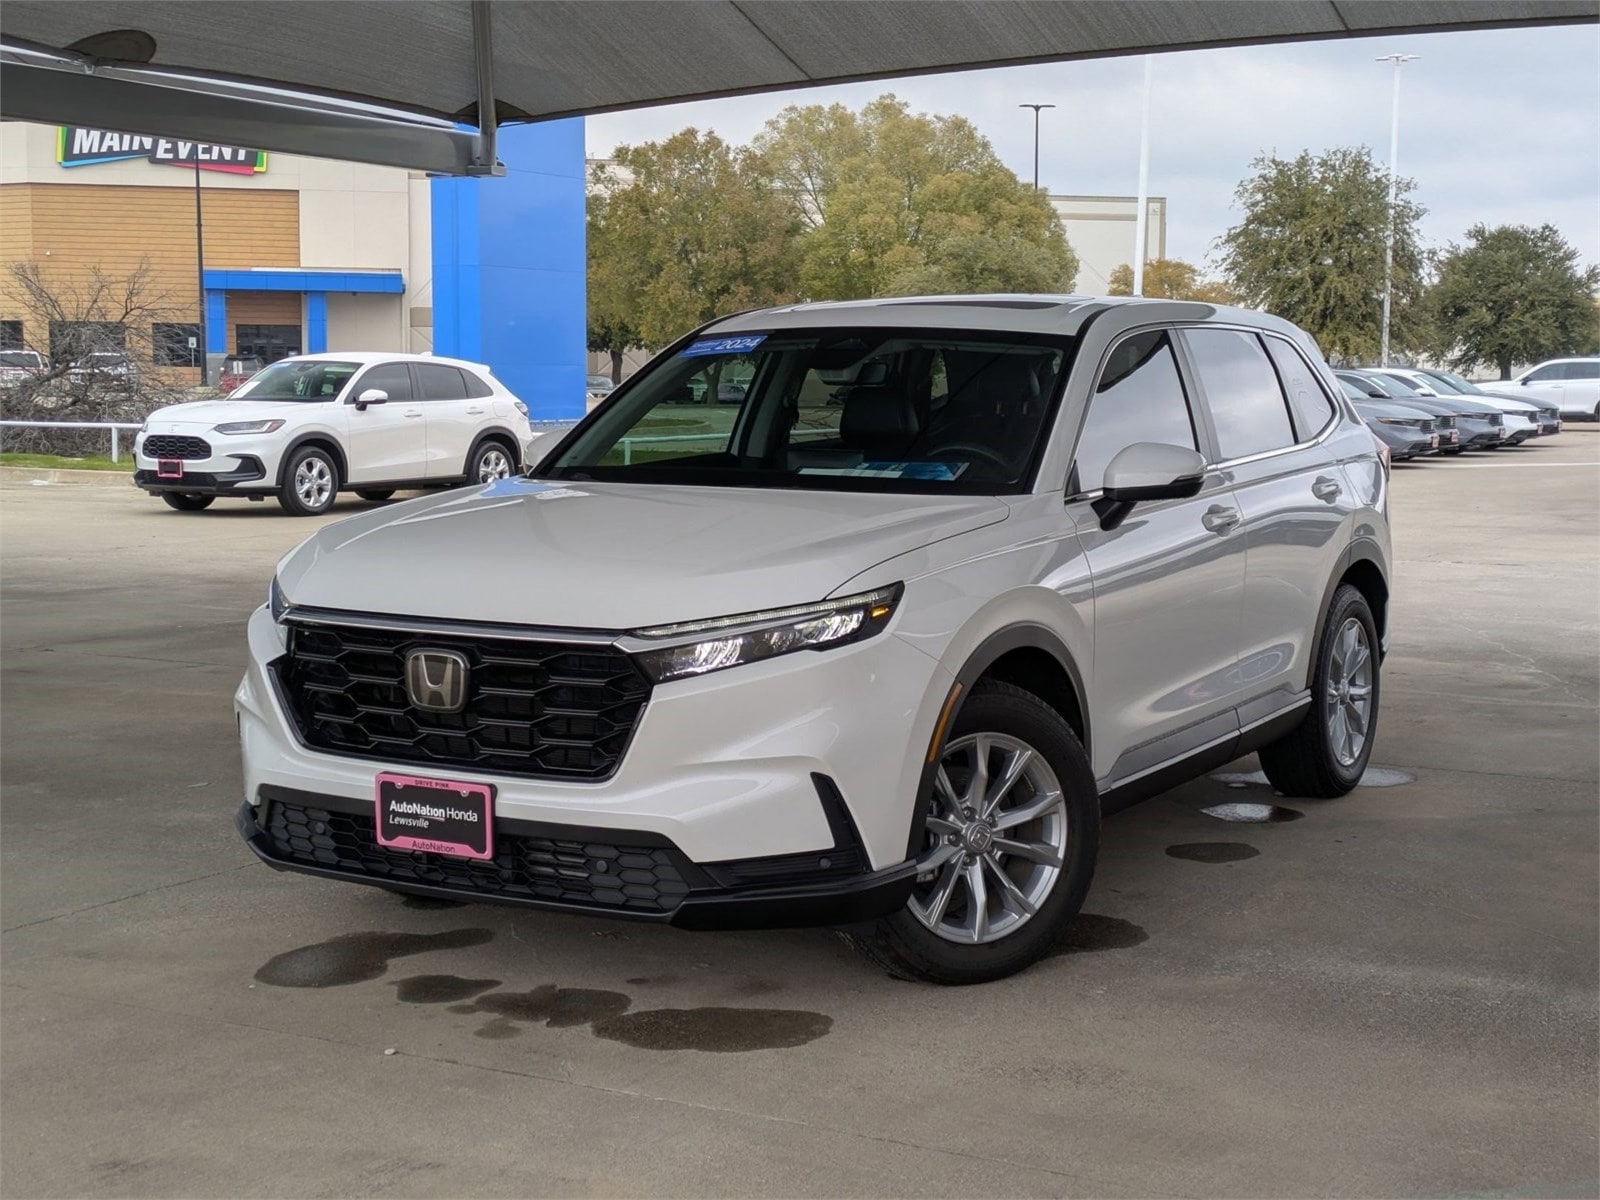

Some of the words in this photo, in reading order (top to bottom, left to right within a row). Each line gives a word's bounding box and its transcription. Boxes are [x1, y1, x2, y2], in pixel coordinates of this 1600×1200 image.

[72, 128, 152, 154] MAIN
[715, 338, 760, 350] 2024
[414, 779, 433, 787] DRIVE
[435, 781, 450, 789] PINK
[389, 800, 445, 818] AutoNation
[446, 807, 478, 822] Honda
[389, 815, 429, 828] Lewisville
[411, 840, 455, 853] AutoNation
